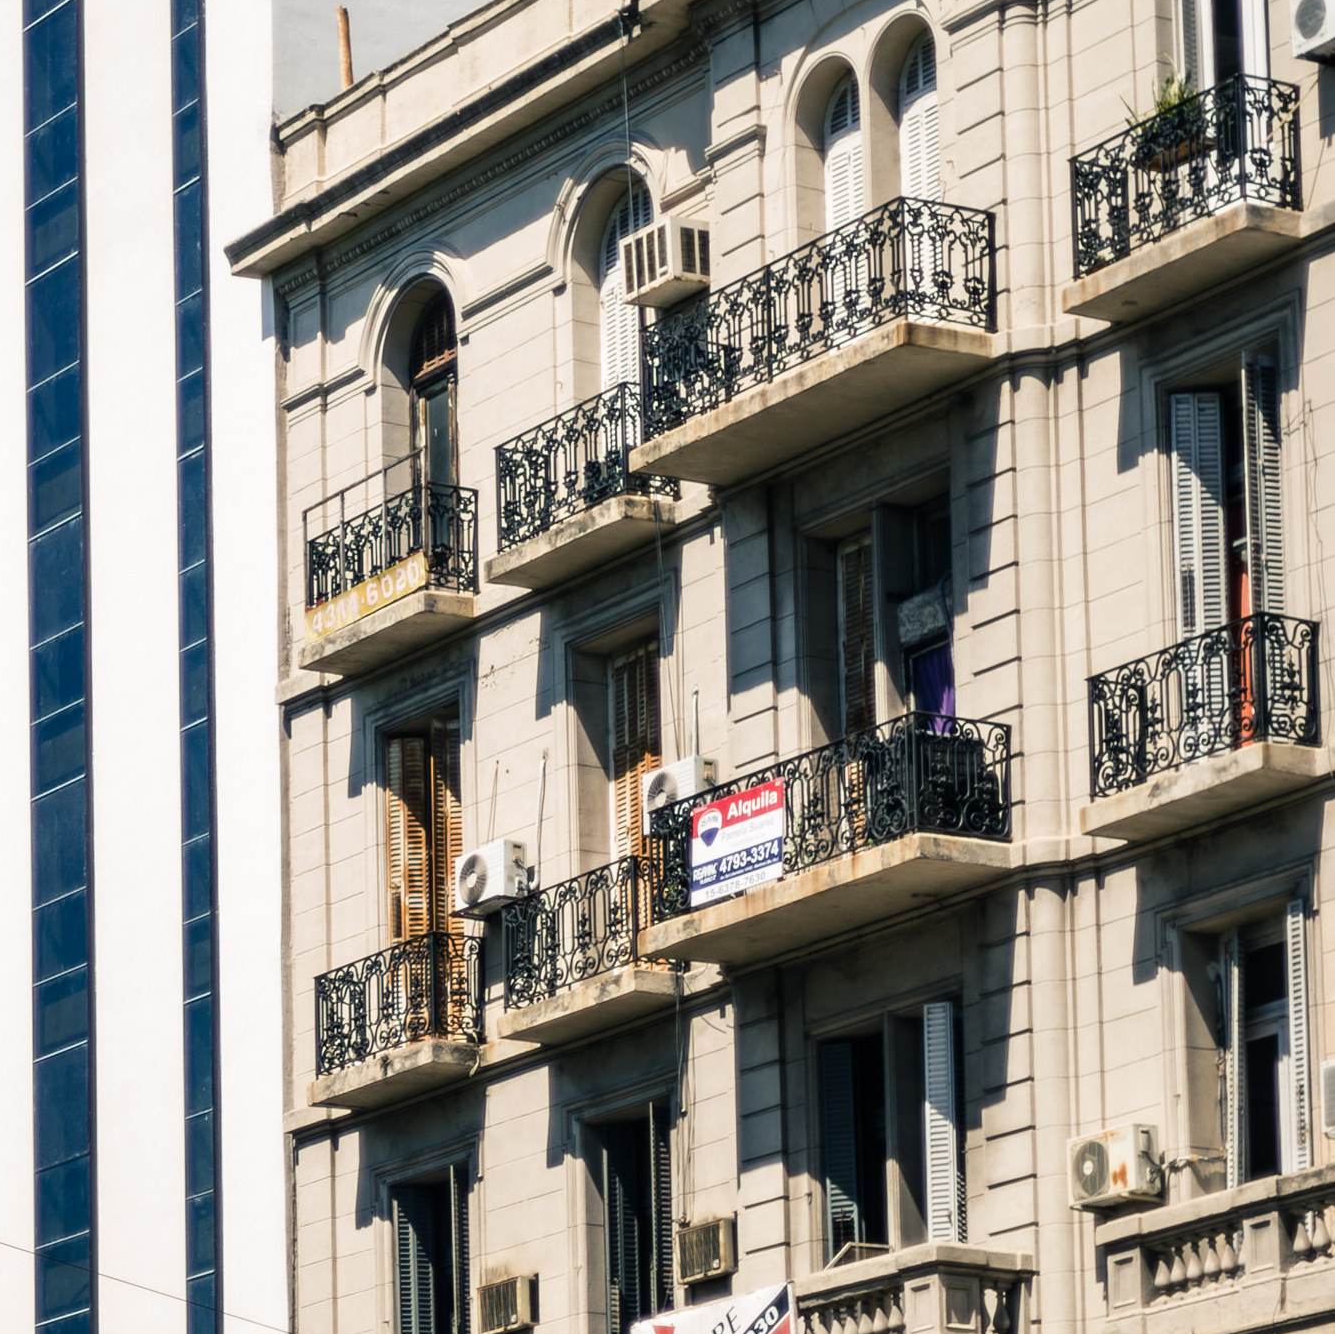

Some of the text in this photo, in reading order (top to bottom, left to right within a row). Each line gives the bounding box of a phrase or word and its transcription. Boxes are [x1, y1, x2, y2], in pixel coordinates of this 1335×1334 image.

[726, 790, 778, 821] Alquila
[721, 826, 748, 842] Pamela
[719, 839, 780, 874] 4793-3374
[705, 871, 766, 899] 15-6378-7630
